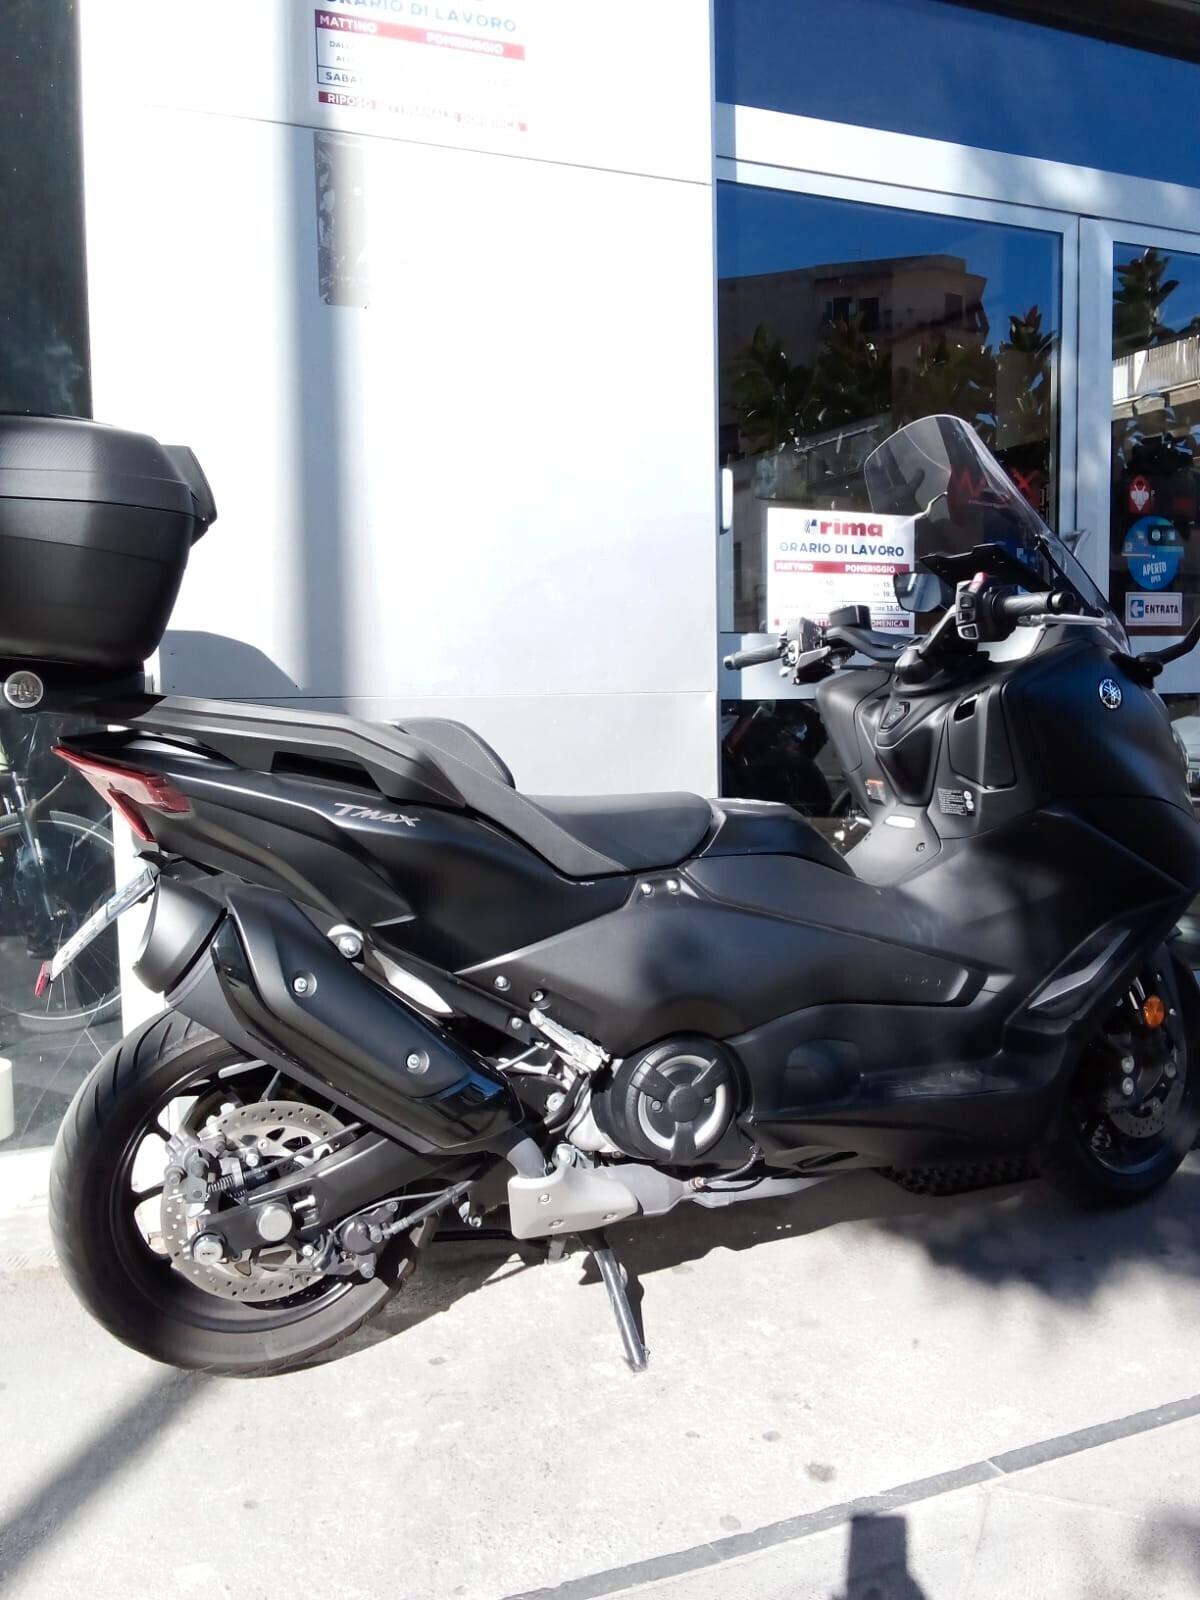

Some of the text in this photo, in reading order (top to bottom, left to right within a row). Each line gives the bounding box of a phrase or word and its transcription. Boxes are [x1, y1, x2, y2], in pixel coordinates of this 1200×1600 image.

[319, 14, 378, 34] MATTINO
[410, 3, 429, 17] DI
[435, 7, 517, 33] LAVORO
[779, 542, 905, 557] ORARIO DI LAVORO
[844, 563, 896, 574] POMERIGGIO
[1142, 561, 1167, 577] APERTO
[1144, 603, 1179, 614] ENTRATA
[871, 620, 904, 628] OMENICA
